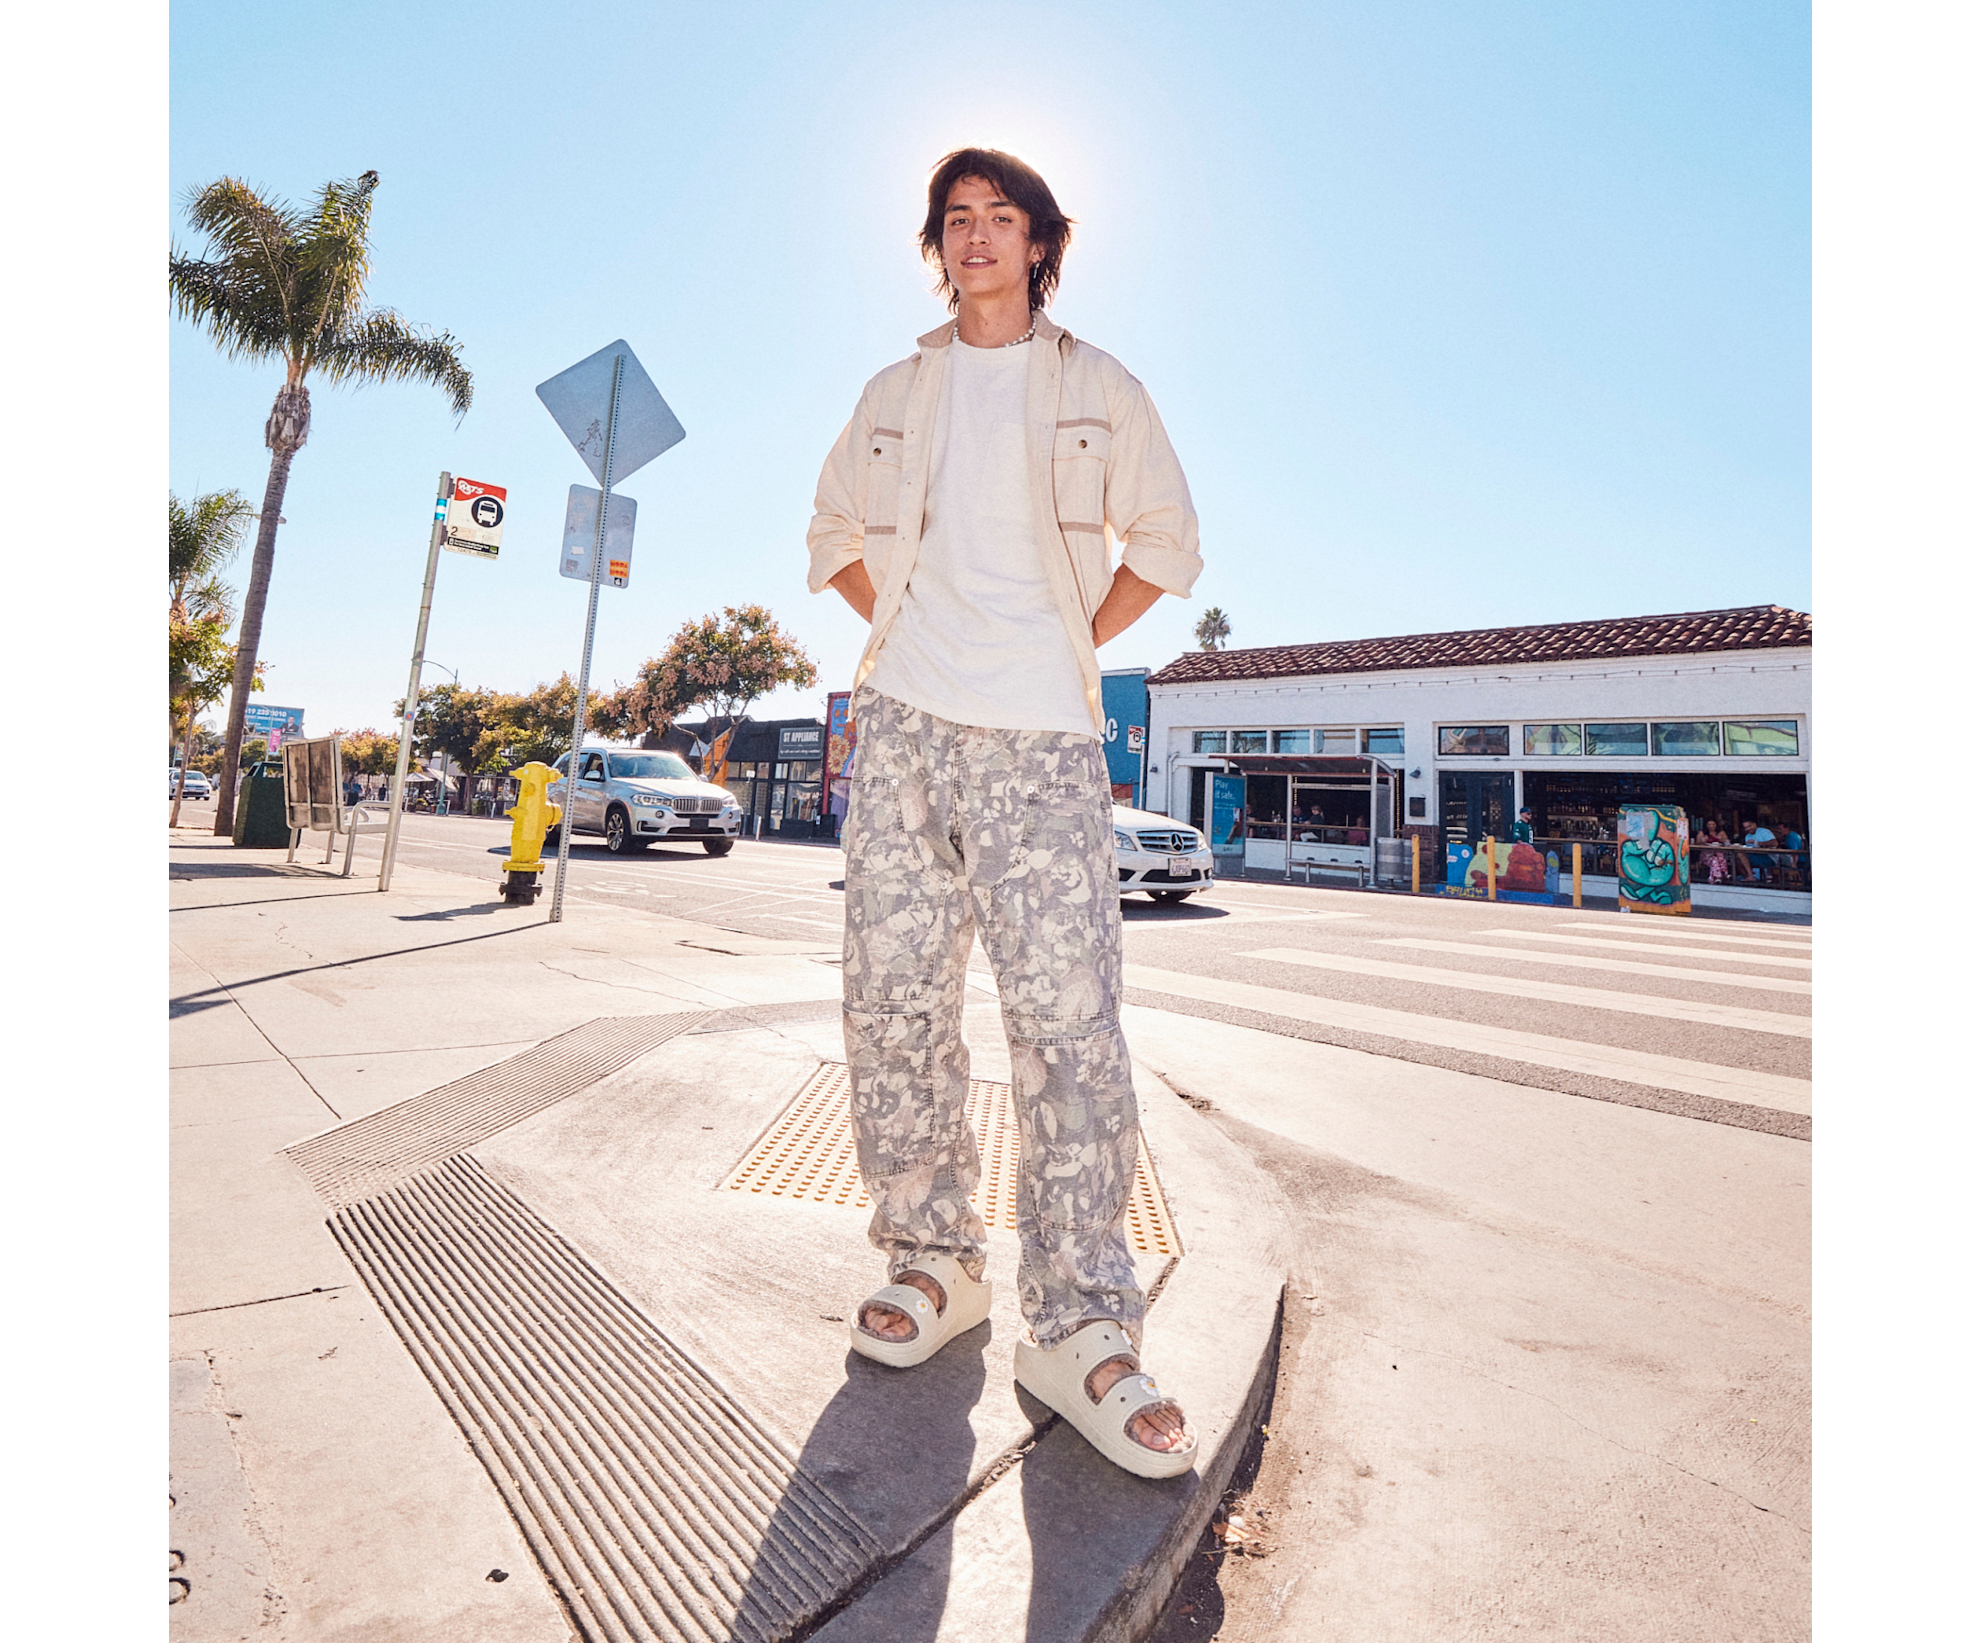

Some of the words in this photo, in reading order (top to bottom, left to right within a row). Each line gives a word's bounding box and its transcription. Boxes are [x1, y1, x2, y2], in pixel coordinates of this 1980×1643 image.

[450, 526, 459, 537] 2
[783, 732, 791, 742] ST
[791, 731, 820, 742] APPLIANCE
[1215, 779, 1228, 790] Play
[1215, 790, 1220, 799] it
[1221, 791, 1235, 800] safe.
